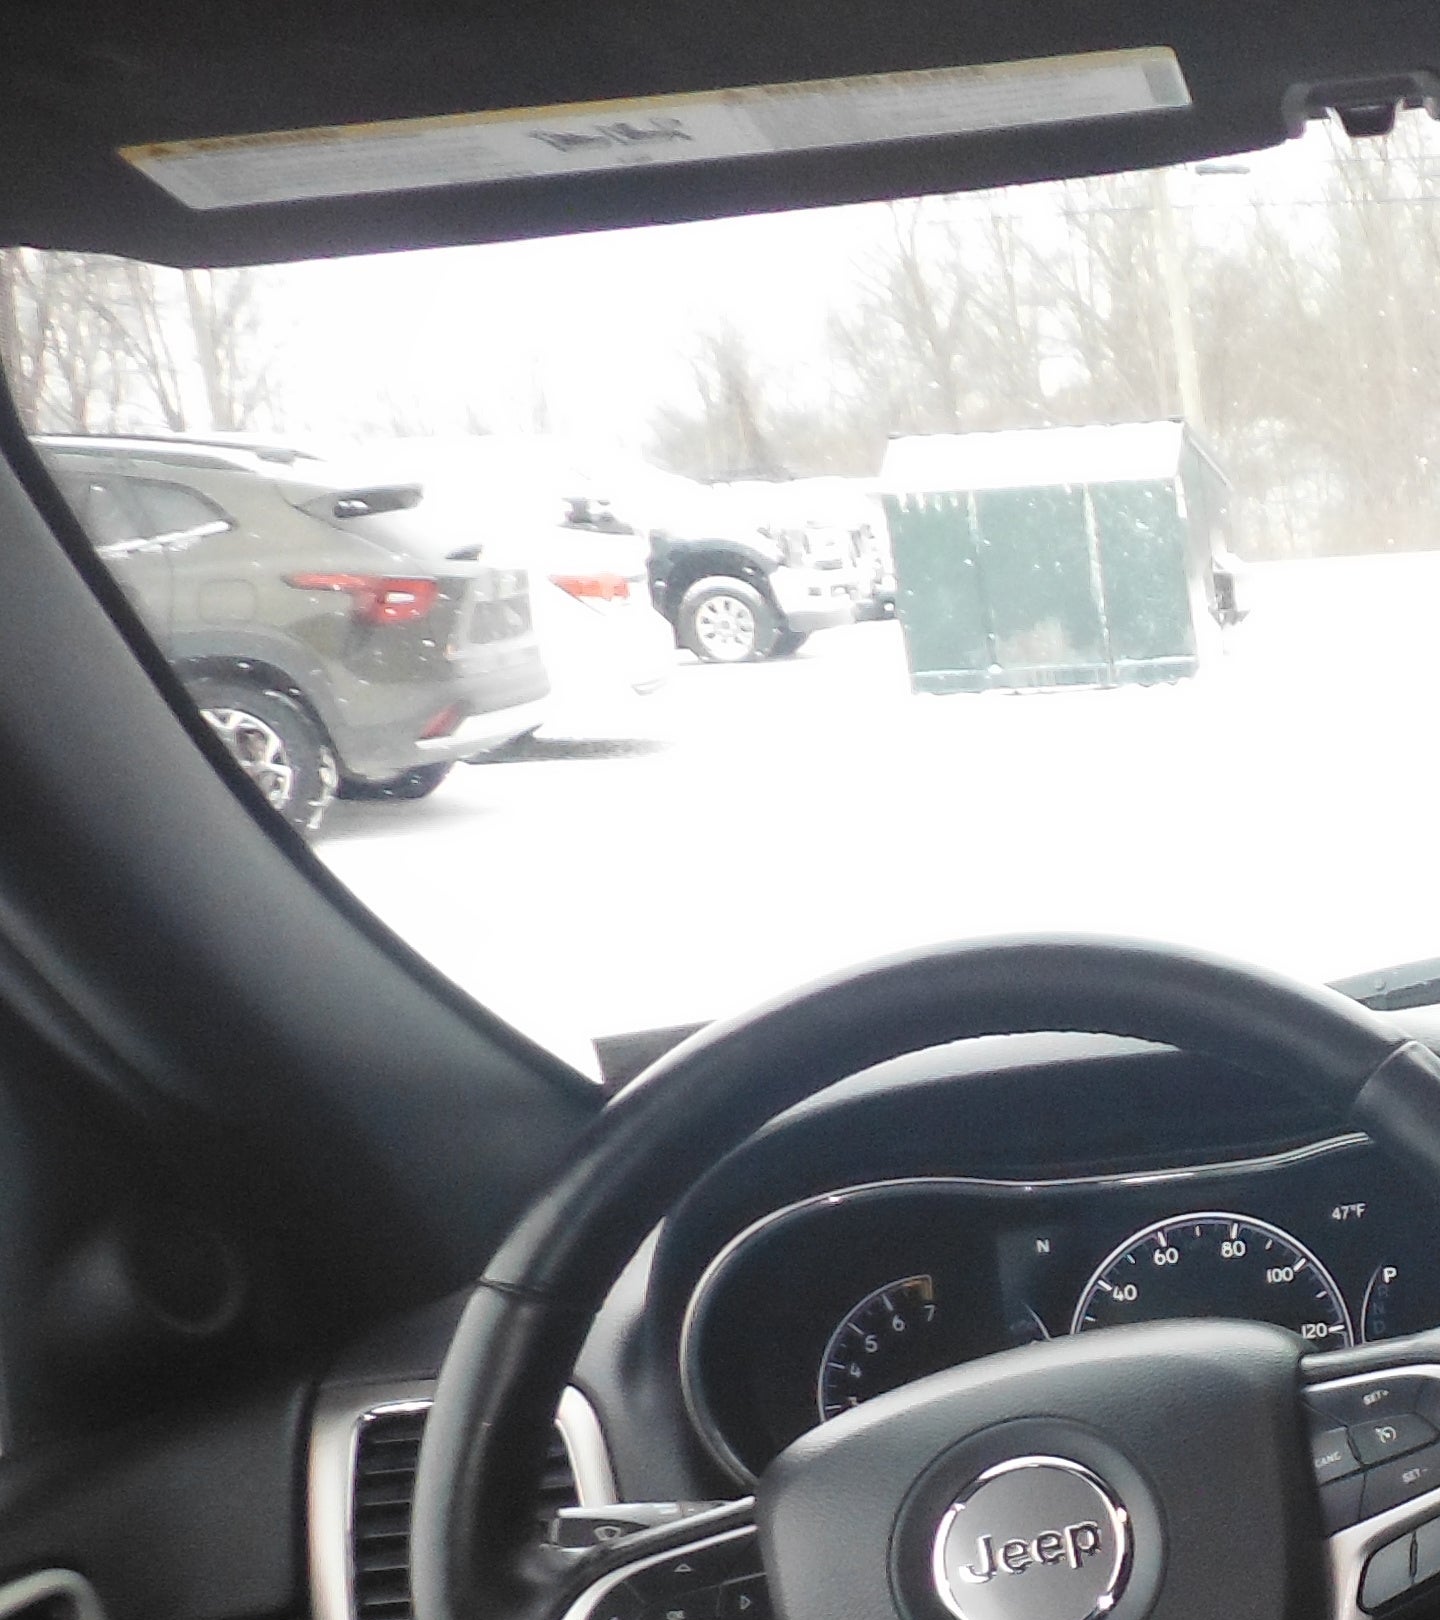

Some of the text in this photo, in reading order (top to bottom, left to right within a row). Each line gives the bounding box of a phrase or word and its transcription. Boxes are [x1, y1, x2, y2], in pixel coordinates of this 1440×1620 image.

[1331, 1203, 1366, 1220] 47°F
[1036, 1239, 1050, 1253] N
[1221, 1240, 1246, 1257] 80
[1154, 1248, 1178, 1265] 60
[1267, 1267, 1294, 1283] 100
[1383, 1267, 1397, 1283] P
[1113, 1284, 1137, 1301] 40
[924, 1304, 936, 1322] 7
[892, 1314, 906, 1332] 6
[1302, 1322, 1327, 1338] 120
[864, 1335, 878, 1353] 5
[849, 1363, 862, 1379] 4
[958, 1520, 1102, 1584] Jeep
